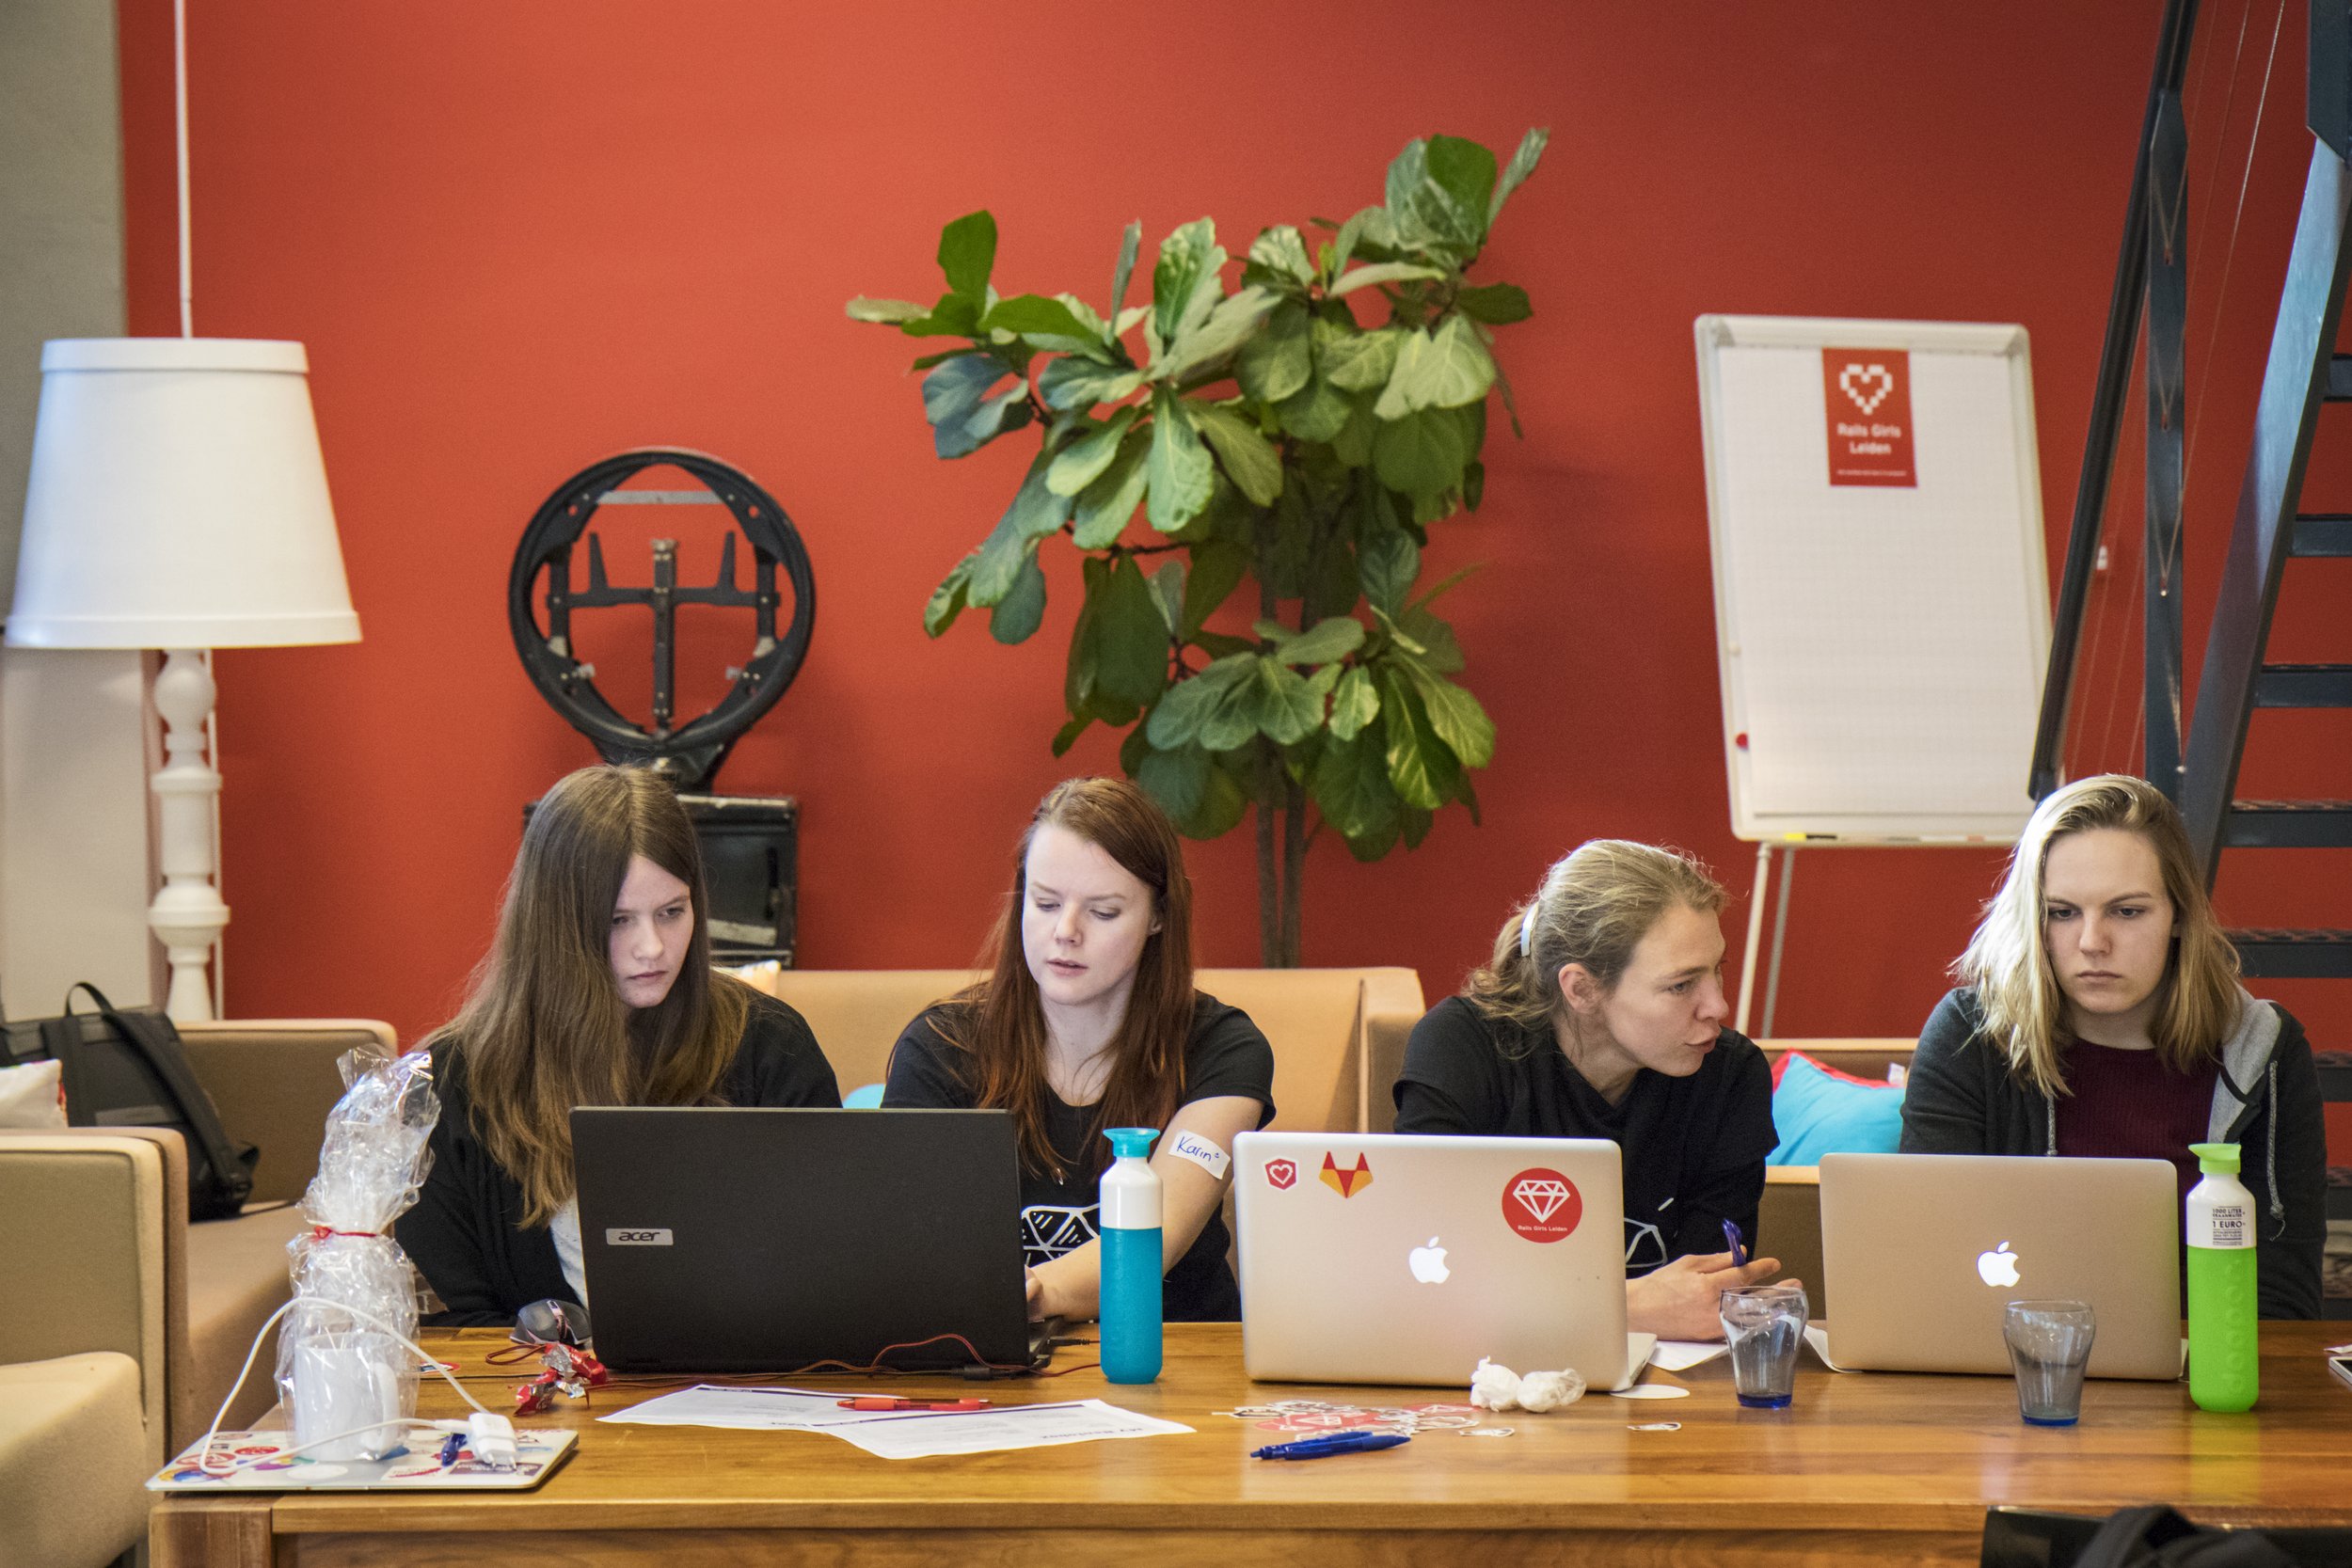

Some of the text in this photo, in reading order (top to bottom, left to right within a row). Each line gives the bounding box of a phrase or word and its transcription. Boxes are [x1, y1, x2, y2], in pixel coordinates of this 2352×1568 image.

[1836, 422, 1901, 438] Rails Girls
[1849, 441, 1892, 455] Leiden
[1176, 1135, 1212, 1163] Karin
[618, 1231, 660, 1242] acer
